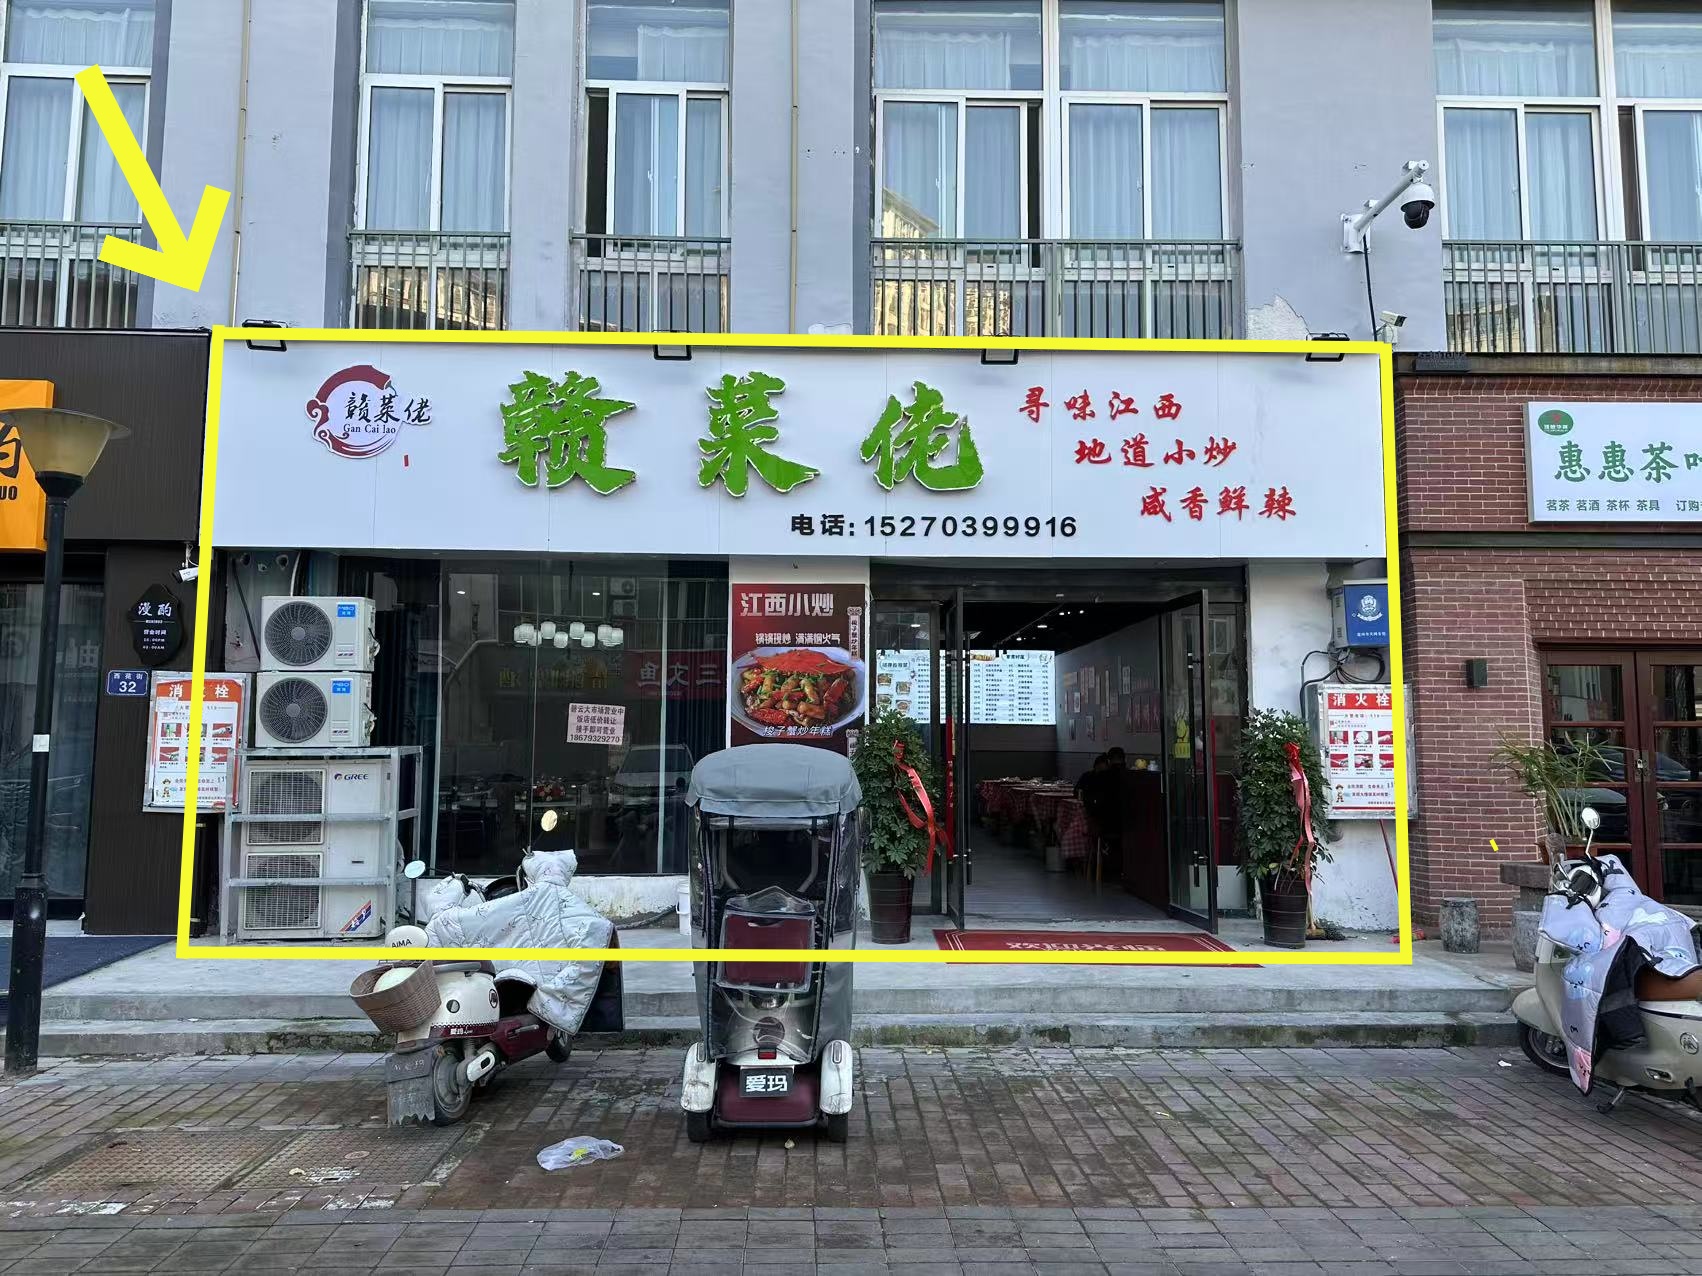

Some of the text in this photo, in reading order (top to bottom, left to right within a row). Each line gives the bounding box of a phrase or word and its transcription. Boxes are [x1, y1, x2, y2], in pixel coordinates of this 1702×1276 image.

[344, 391, 431, 423] 赣菜佬
[1018, 386, 1183, 423] 寻味江西
[343, 424, 396, 434] Gan Cai lao
[497, 371, 985, 497] 赣菜佬
[1074, 433, 1238, 468] 地道小炒
[1140, 485, 1297, 522] 咸香鲜辣
[1546, 499, 1702, 512] 茗茶 茗酒 茶杯 茶具 订购
[740, 592, 834, 617] 江西小炒
[119, 681, 137, 693] 32
[169, 684, 229, 698] 消栓
[1333, 693, 1391, 707] 消火栓
[570, 734, 620, 743] 18679329270
[344, 773, 369, 781] GREE
[745, 1074, 788, 1093] 爱玛
